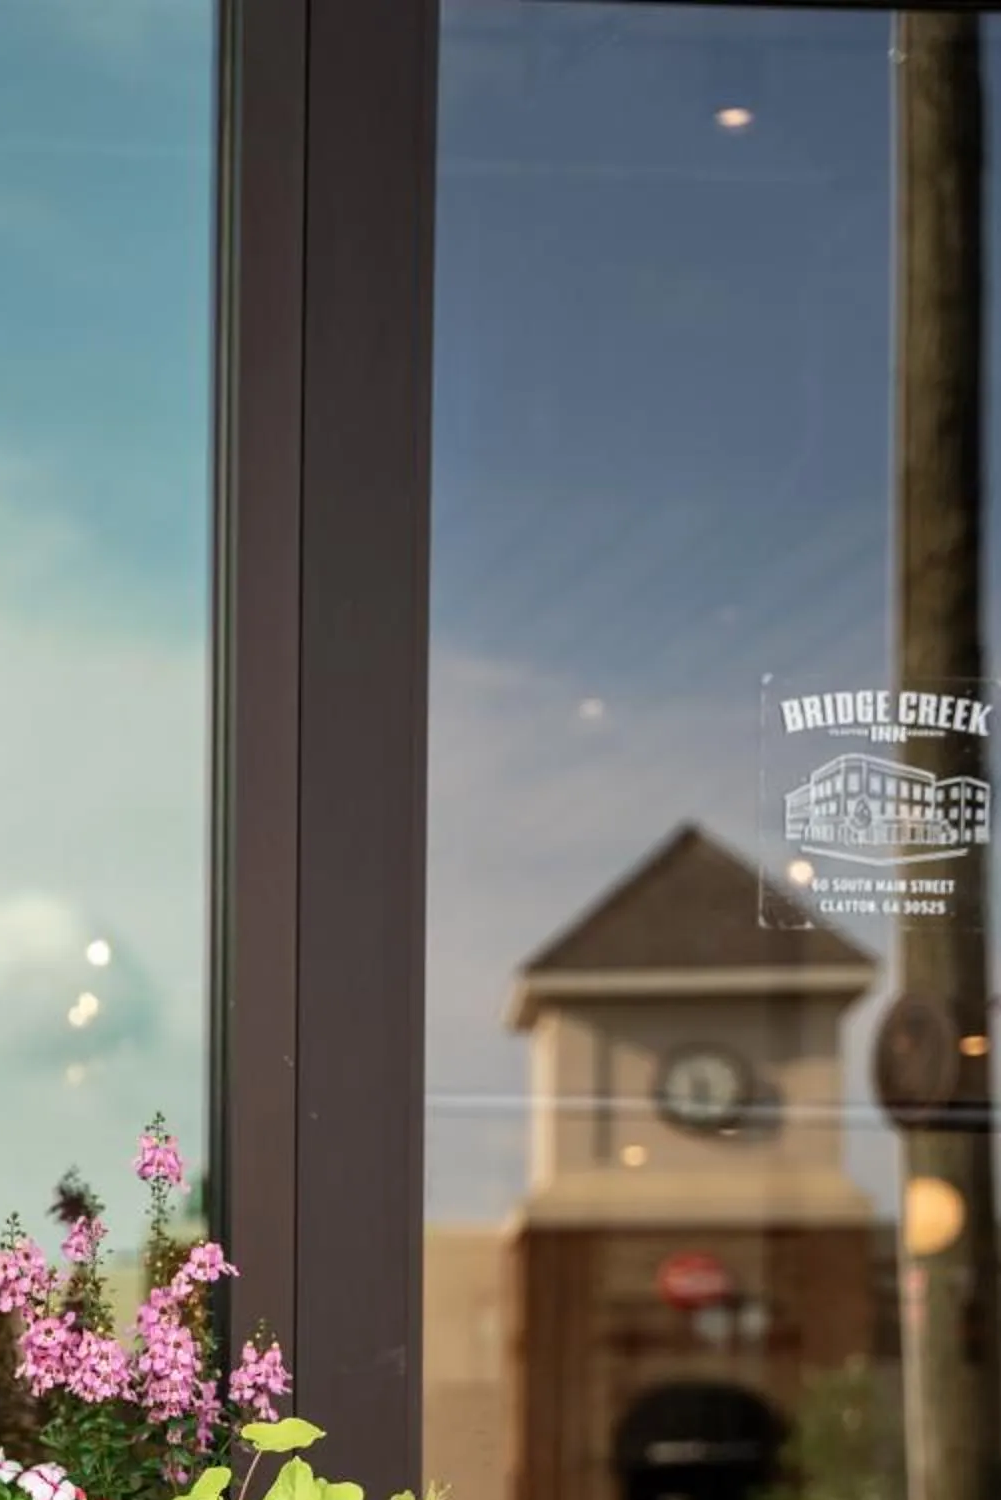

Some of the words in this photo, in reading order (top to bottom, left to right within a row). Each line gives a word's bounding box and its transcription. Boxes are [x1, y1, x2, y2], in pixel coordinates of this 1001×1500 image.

[780, 690, 891, 733] BRIDGE
[898, 690, 993, 736] CREEK
[870, 726, 908, 742] INN
[831, 878, 873, 892] SOUTH
[875, 879, 907, 892] MAIN
[910, 879, 955, 894] STREET
[903, 900, 946, 915] 30525
